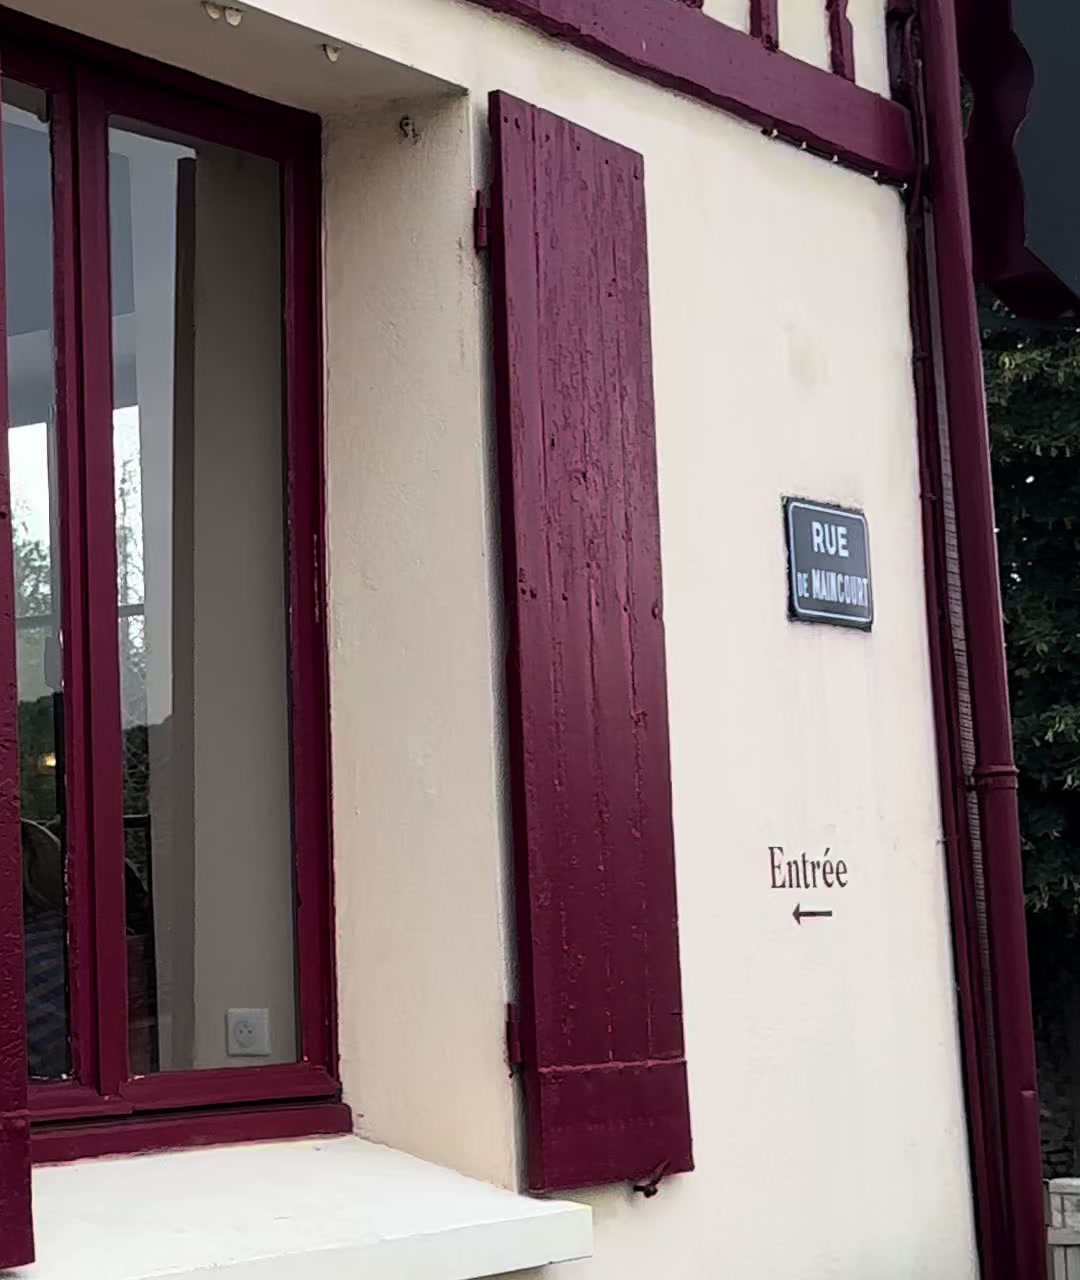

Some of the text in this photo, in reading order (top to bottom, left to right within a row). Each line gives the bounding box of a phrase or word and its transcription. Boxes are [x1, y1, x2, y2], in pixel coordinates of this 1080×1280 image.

[811, 521, 849, 557] RUE
[796, 571, 809, 598] DE
[768, 846, 848, 889] Entrée
